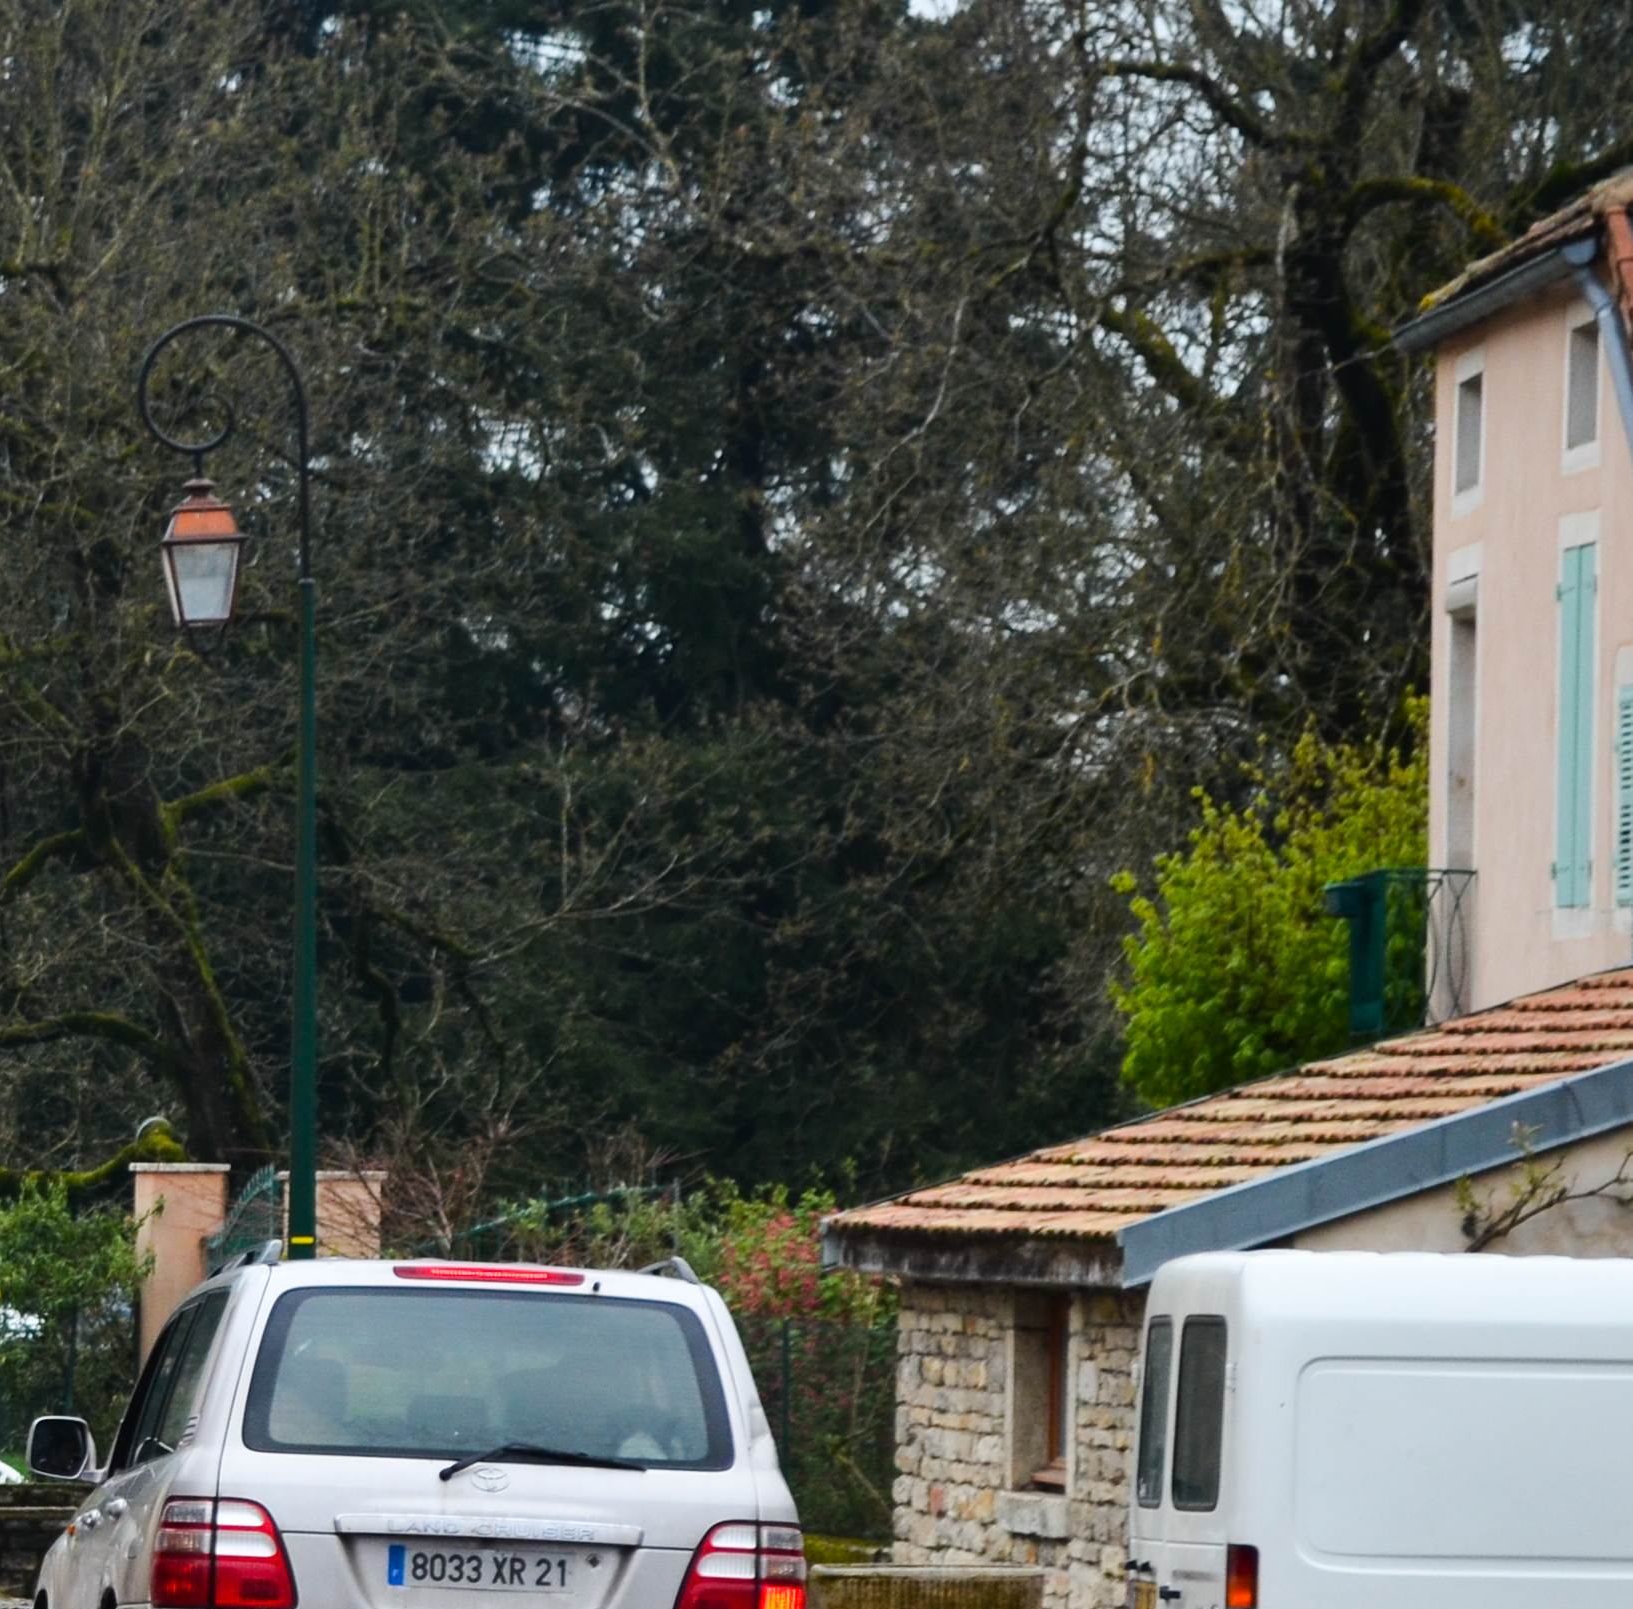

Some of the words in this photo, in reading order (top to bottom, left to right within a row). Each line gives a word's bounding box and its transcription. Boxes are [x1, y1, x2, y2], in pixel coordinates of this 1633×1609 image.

[387, 1518, 460, 1535] LAND
[472, 1523, 596, 1541] CRUISER
[411, 1552, 483, 1584] 8033
[492, 1556, 527, 1585] XR
[535, 1558, 567, 1587] 21
